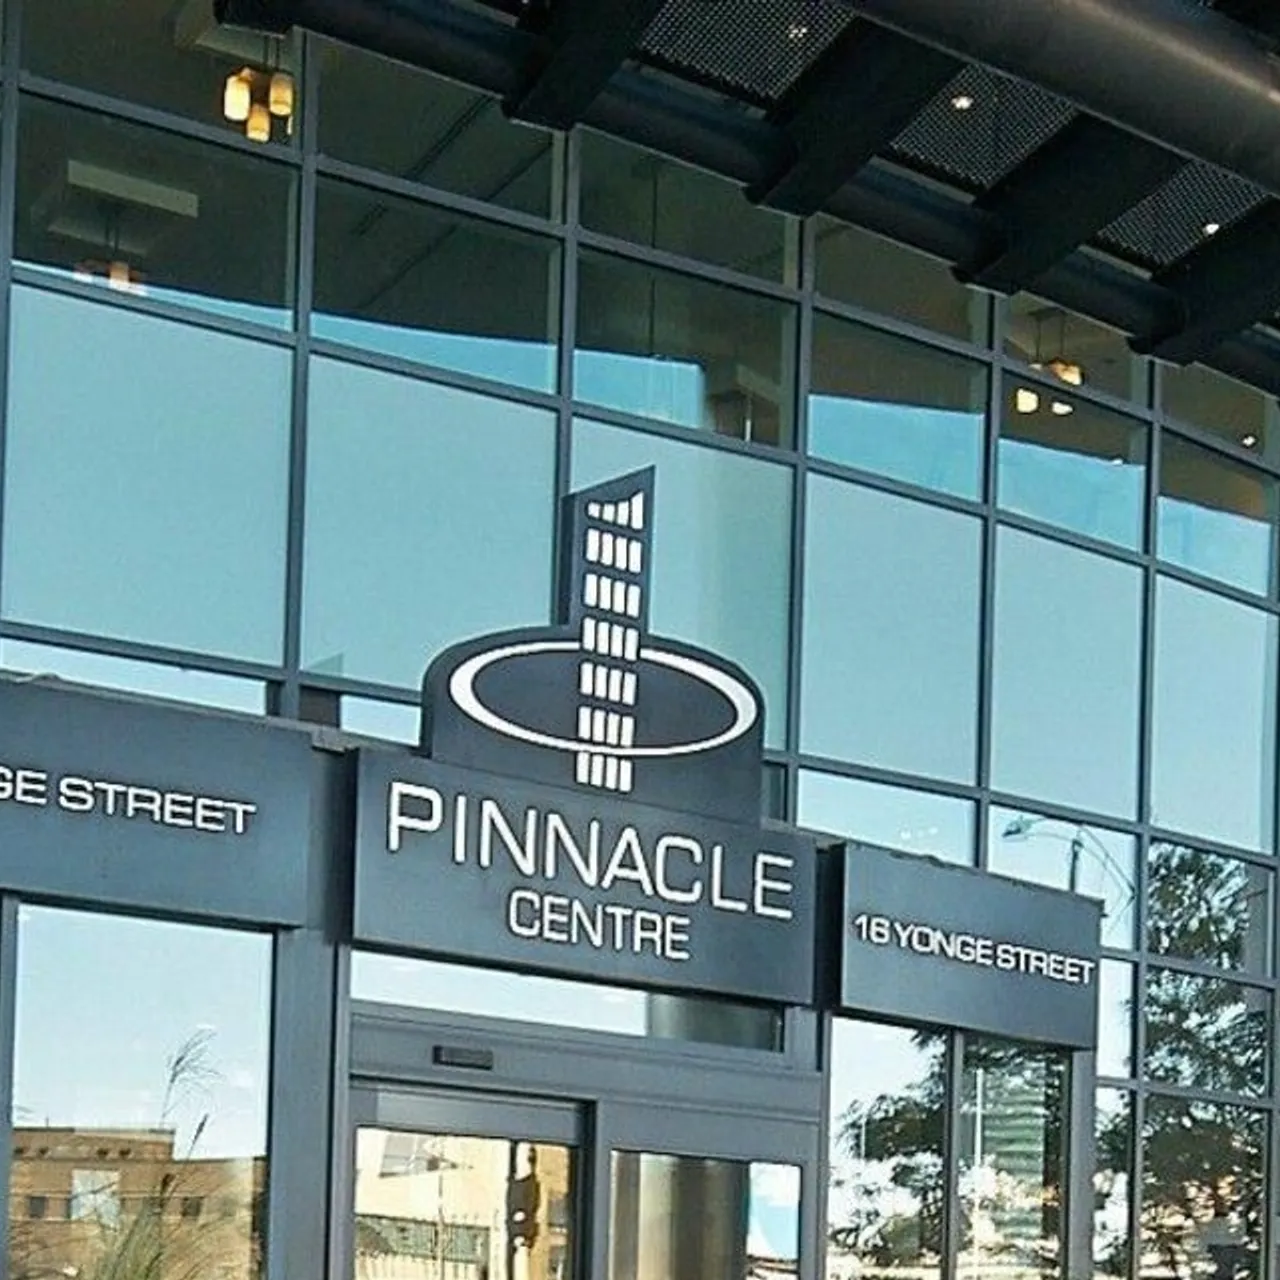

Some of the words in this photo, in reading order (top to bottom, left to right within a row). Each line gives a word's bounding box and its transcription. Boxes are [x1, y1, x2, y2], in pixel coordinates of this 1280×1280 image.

[58, 776, 257, 834] STREET
[386, 781, 796, 920] PINNACLE
[508, 891, 692, 960] CENTRE
[854, 913, 890, 945] 16
[893, 921, 994, 966] YONGE
[996, 944, 1096, 985] STREET
